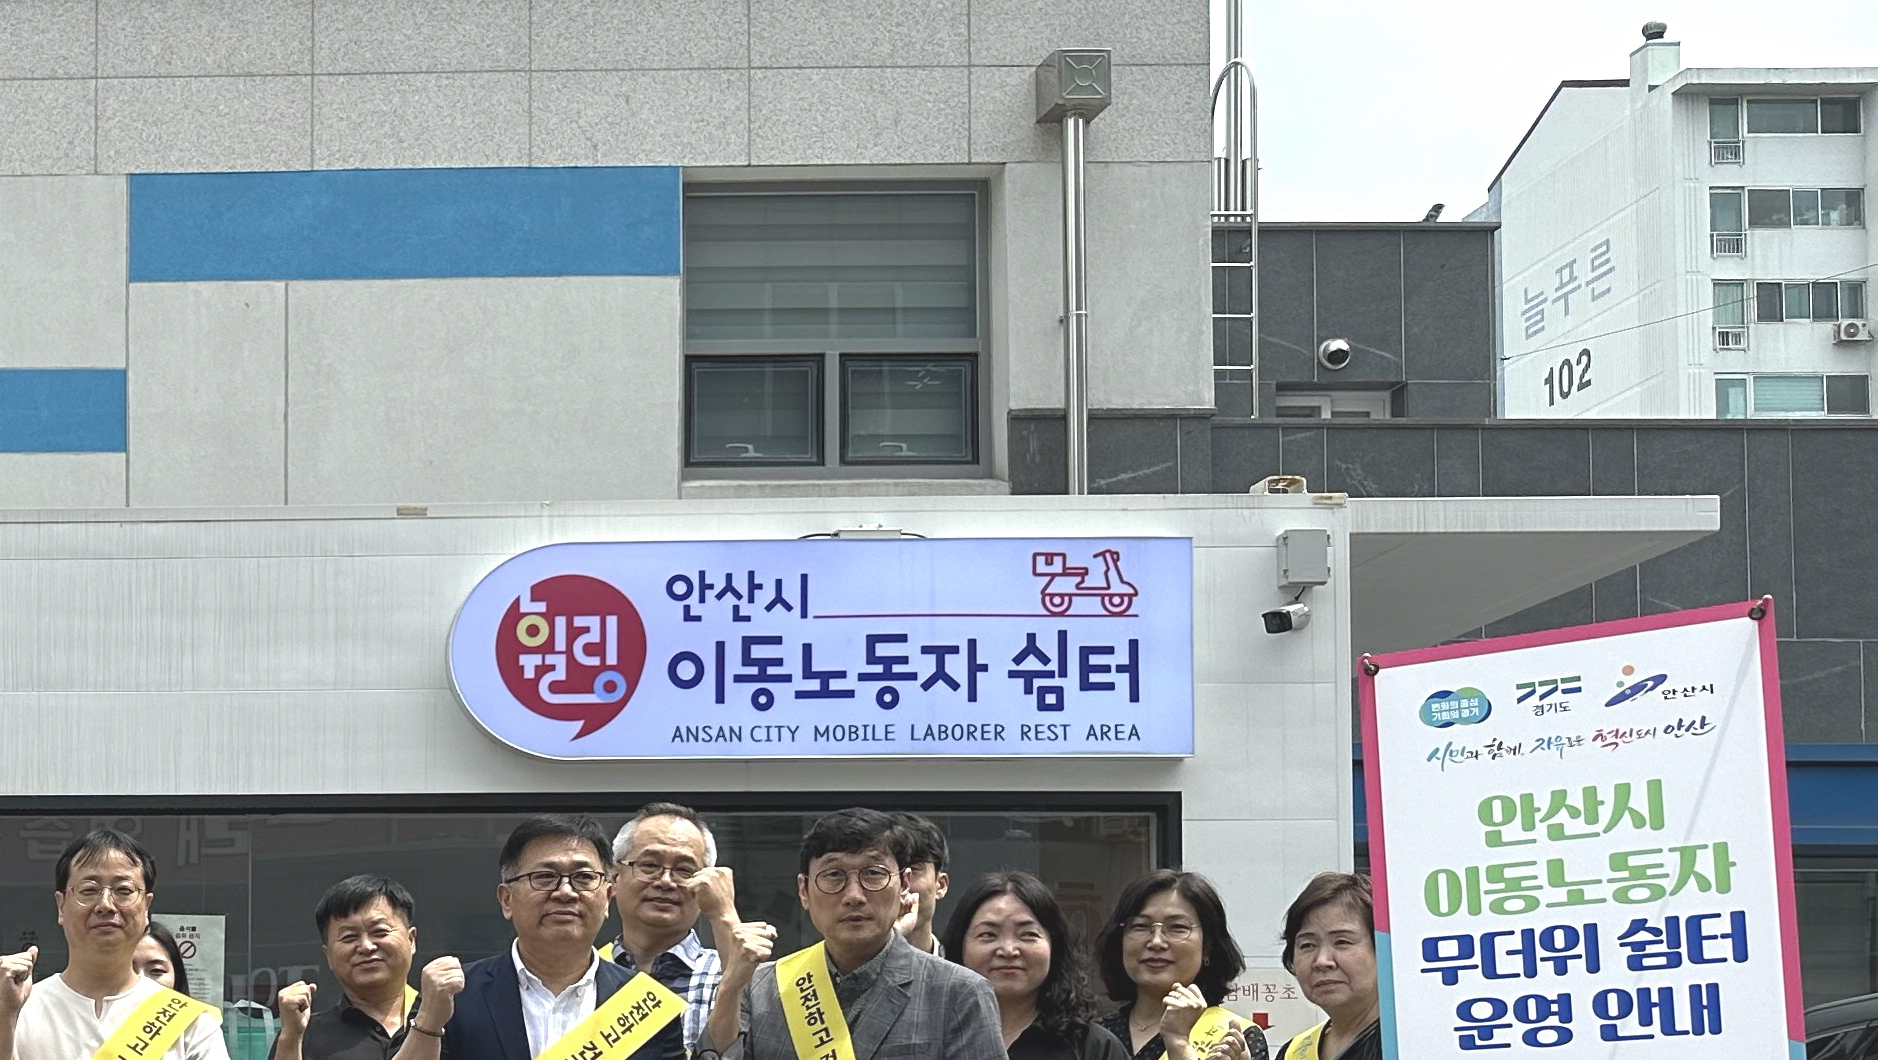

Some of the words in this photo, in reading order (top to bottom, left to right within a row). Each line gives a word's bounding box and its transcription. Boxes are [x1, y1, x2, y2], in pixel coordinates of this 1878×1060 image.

[1518, 237, 1617, 340] 늘푸른
[1544, 348, 1593, 407] 102
[665, 569, 809, 623] 안산시
[667, 633, 989, 712] 이동노동자
[1007, 629, 1140, 712] 쉼터
[1661, 683, 1714, 701] 안산시
[671, 725, 742, 743] ANSAN
[749, 725, 800, 743] CITY
[813, 723, 896, 743] MOBILE
[910, 723, 1006, 742] LABORER
[1020, 723, 1071, 742] REST
[1085, 723, 1141, 742] AREA
[1533, 701, 1571, 717] 경기도
[1426, 741, 1479, 772] 시민과
[1529, 736, 1584, 759] 자유로운
[1591, 726, 1657, 751] 혁신도시
[1663, 716, 1716, 739] 안산
[1477, 778, 1666, 849] 안산시
[1423, 841, 1738, 918] 이동노동자
[1420, 922, 1601, 987] 무더위
[1616, 910, 1749, 972] 쉼터
[127, 997, 189, 1056] 안전하고
[600, 990, 663, 1048] 안전하고
[795, 972, 834, 1049] 안전하고
[1453, 992, 1574, 1051] 운영
[1591, 982, 1723, 1042] 안내
